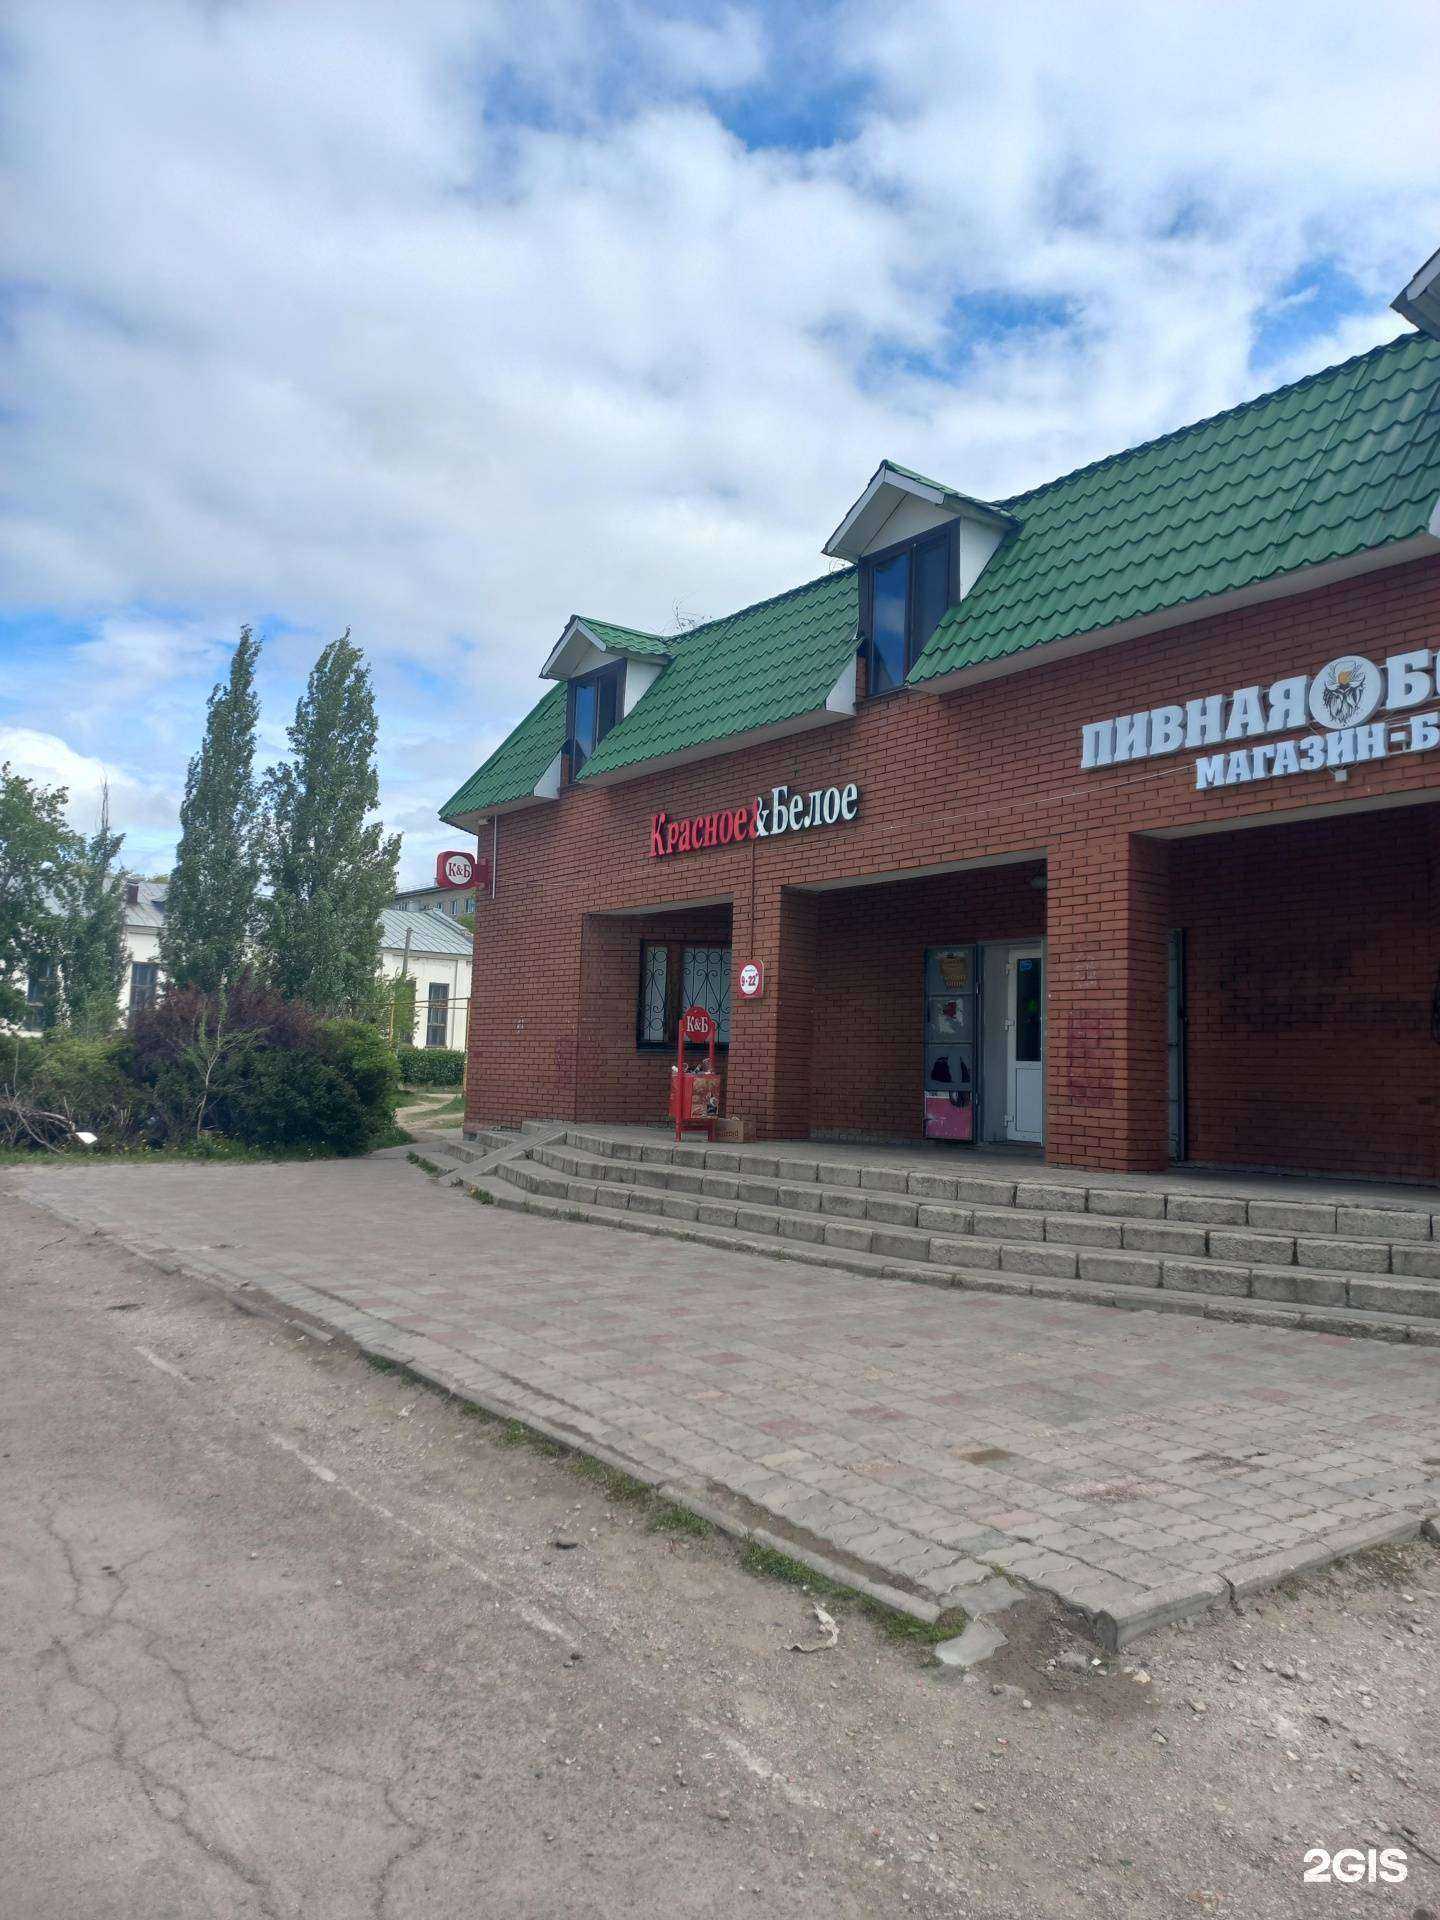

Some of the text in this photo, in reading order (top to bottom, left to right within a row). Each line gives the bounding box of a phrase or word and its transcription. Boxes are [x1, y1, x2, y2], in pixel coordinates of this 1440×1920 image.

[1081, 648, 1440, 769] ПИВНАЯ Б
[448, 862, 471, 878] К&Б
[686, 1015, 709, 1033] К&Б
